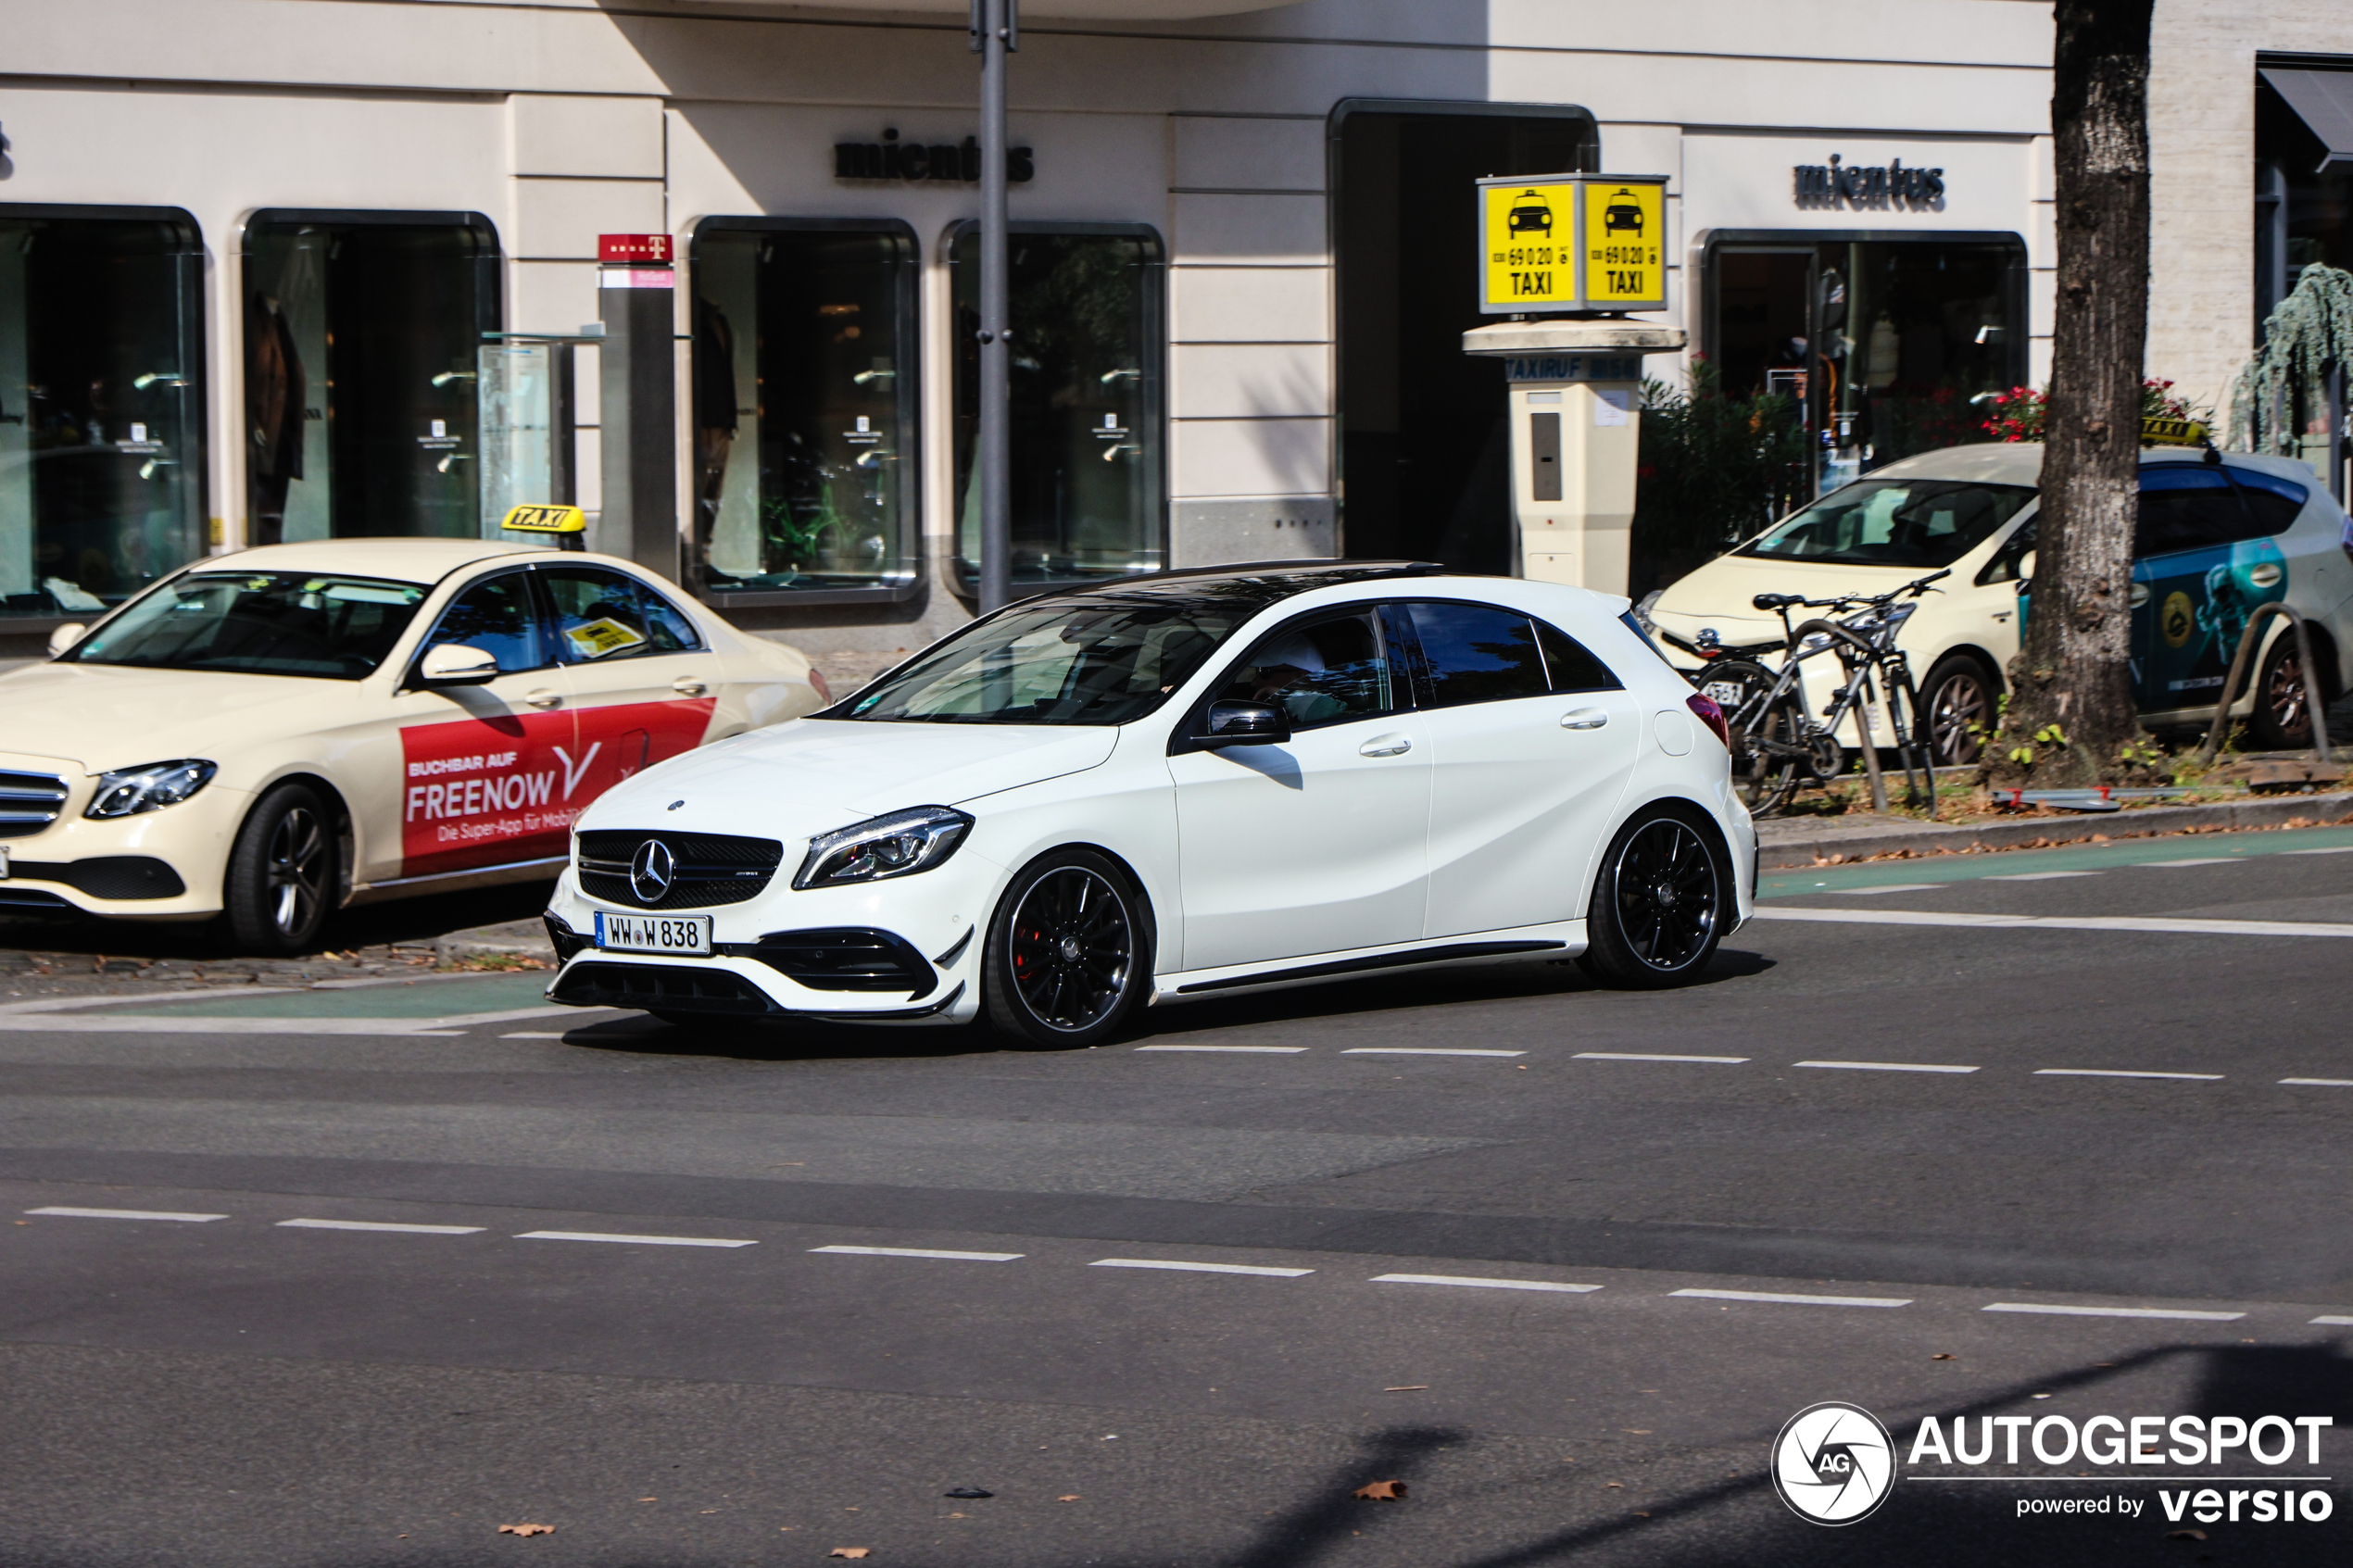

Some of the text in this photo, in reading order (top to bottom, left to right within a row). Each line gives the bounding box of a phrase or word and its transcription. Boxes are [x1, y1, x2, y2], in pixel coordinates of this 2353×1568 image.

[835, 128, 1035, 182] mients
[1793, 153, 1944, 199] mientus
[1510, 271, 1553, 295] TAXI
[1606, 270, 1642, 294] TAXI
[1506, 357, 1581, 379] TAXIRUF
[2142, 420, 2184, 436] TAXI
[514, 508, 569, 527] TAXI
[408, 751, 518, 777] BUCHBAR AUF
[406, 771, 556, 822] FREENOW
[436, 822, 459, 842] Die
[460, 818, 523, 840] Super-App
[524, 811, 542, 831] für
[610, 917, 698, 948] WW W 838
